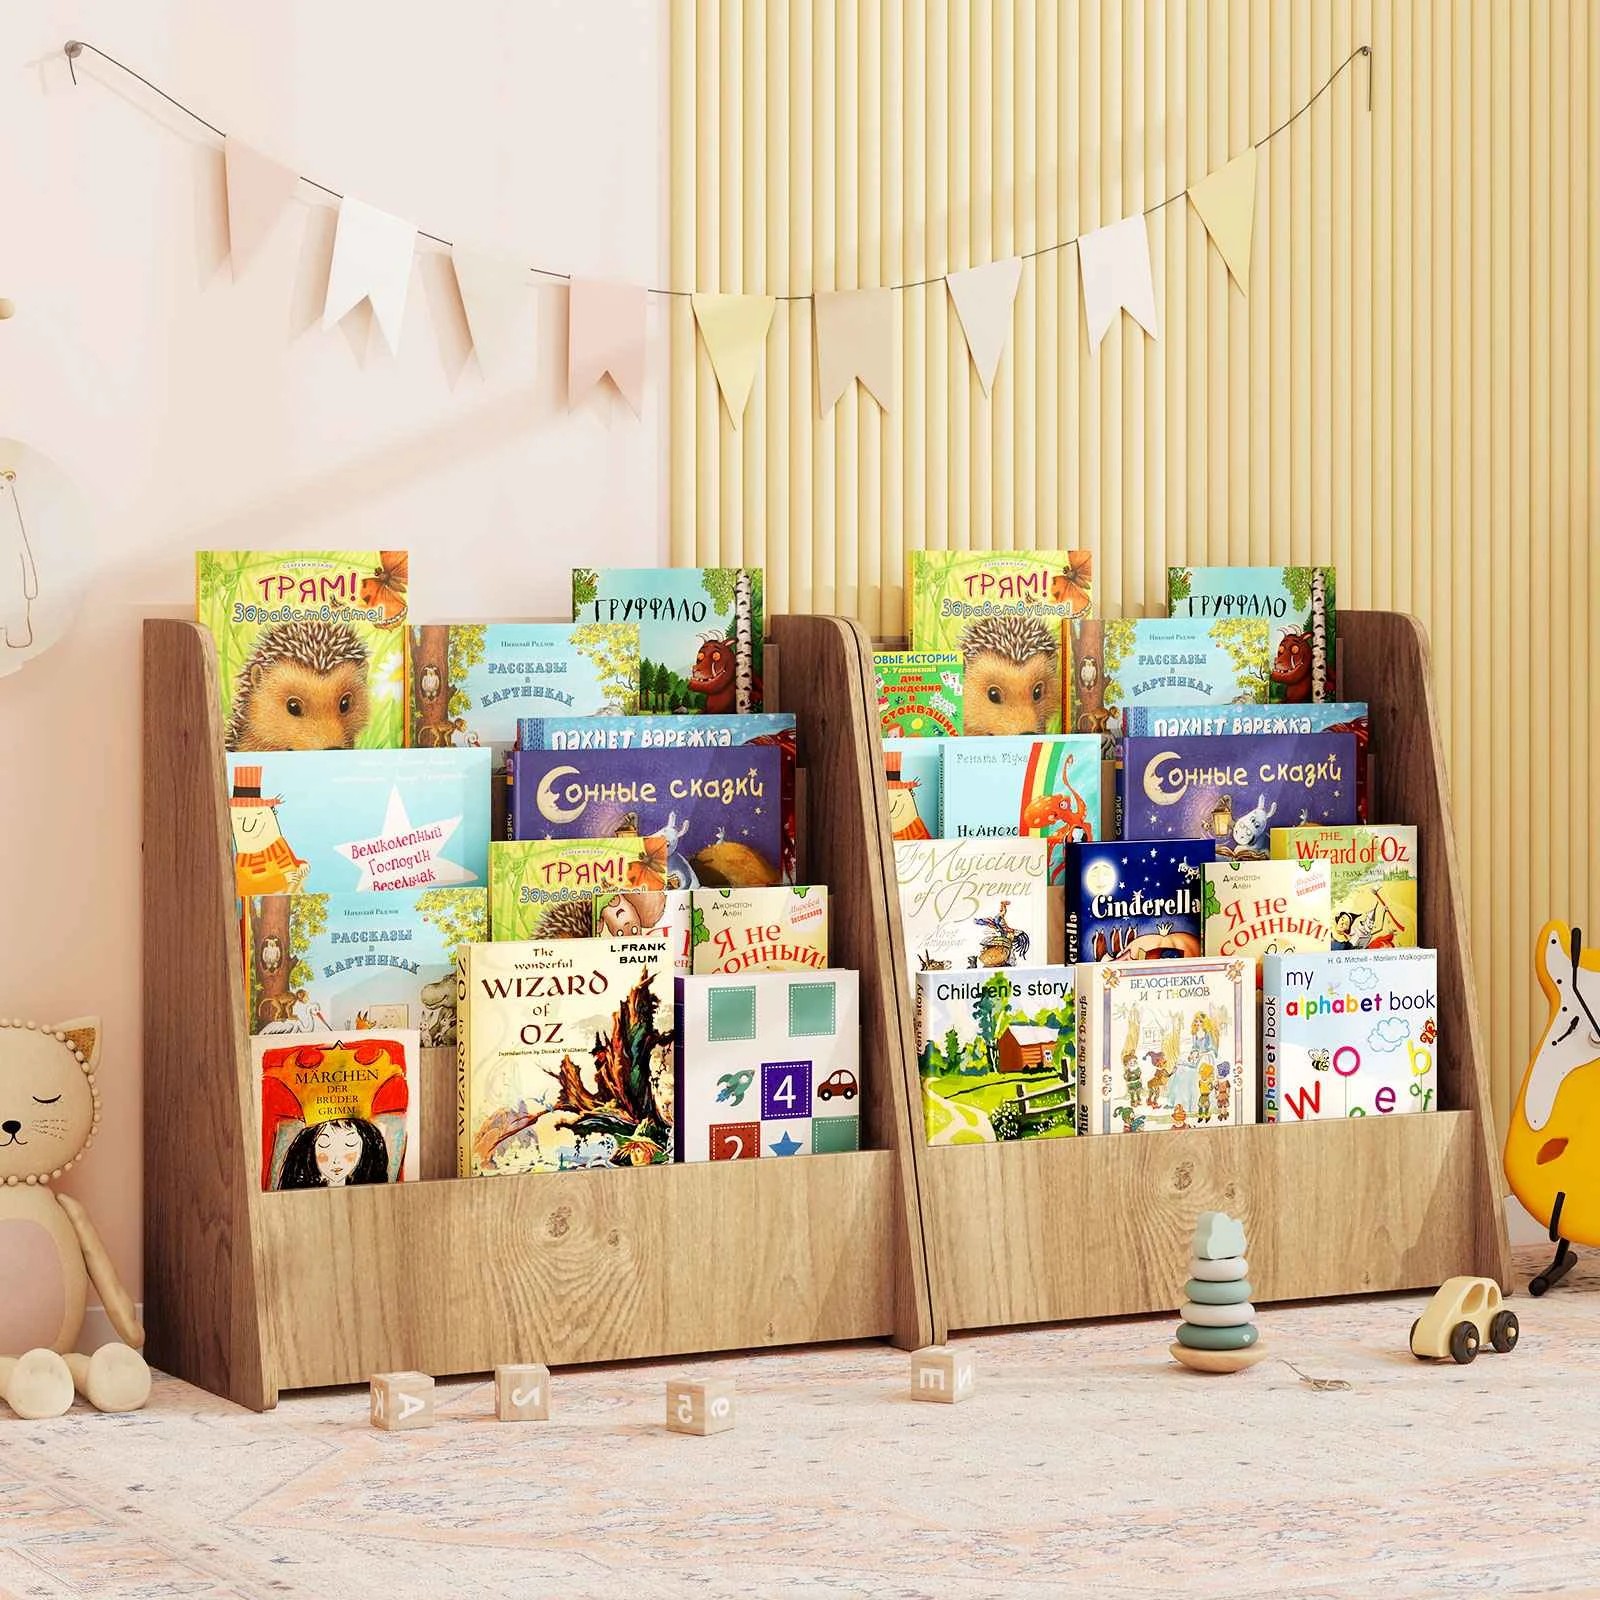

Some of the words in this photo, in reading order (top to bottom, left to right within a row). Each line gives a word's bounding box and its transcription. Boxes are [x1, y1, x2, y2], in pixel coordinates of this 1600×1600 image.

[258, 572, 357, 603] ТРЯМ!
[964, 571, 1048, 599] ТРЯМ!
[232, 602, 384, 624] Здравствуйте!
[594, 597, 707, 623] ГРУФФАЛО
[941, 598, 1072, 619] Здравствуйте!
[1188, 594, 1287, 618] ГРУФФАЛО
[488, 661, 568, 675] РАССКАЗЫ
[907, 654, 958, 664] ИСТОРИИ
[1138, 654, 1207, 666] РАССКАЗЫ
[480, 686, 575, 709] КАРТИНКАХ
[1132, 676, 1214, 697] КАРТИНКАХ
[351, 826, 443, 860] Великолепный
[1320, 831, 1343, 841] THE
[1296, 836, 1359, 864] Wizard
[1360, 836, 1379, 863] of
[1381, 836, 1410, 863] Oz
[368, 849, 431, 876] Господин
[542, 857, 624, 884] ТРЯМ!
[935, 873, 1032, 922] Bremen
[1092, 890, 1200, 918] Cinderella
[1224, 900, 1246, 932] Я
[1254, 897, 1287, 918] не
[331, 929, 412, 943] РАССКАЗЫ
[713, 927, 736, 959] Я
[745, 925, 781, 945] не
[1219, 917, 1329, 957] сонный!
[514, 959, 574, 970] wonderful
[533, 948, 554, 958] The
[619, 955, 658, 964] BAUM
[323, 955, 420, 978] КАРТИНКАХ
[457, 958, 466, 1000] OZ
[937, 982, 1021, 1000] Children's
[1028, 980, 1068, 998] story
[1130, 975, 1205, 989] БЕЛОСНЕЖКА
[1286, 970, 1314, 990] my
[1166, 987, 1210, 999] ГНОМОВ
[1286, 993, 1382, 1020] alphabet
[1390, 989, 1436, 1011] book
[532, 1003, 550, 1016] of
[1265, 997, 1276, 1038] book
[520, 1023, 564, 1045] OZ
[295, 1068, 380, 1085] MÄRCHEN
[327, 1084, 348, 1094] DER
[773, 1074, 797, 1109] 4
[723, 1135, 744, 1161] 2
[398, 1391, 425, 1420] A
